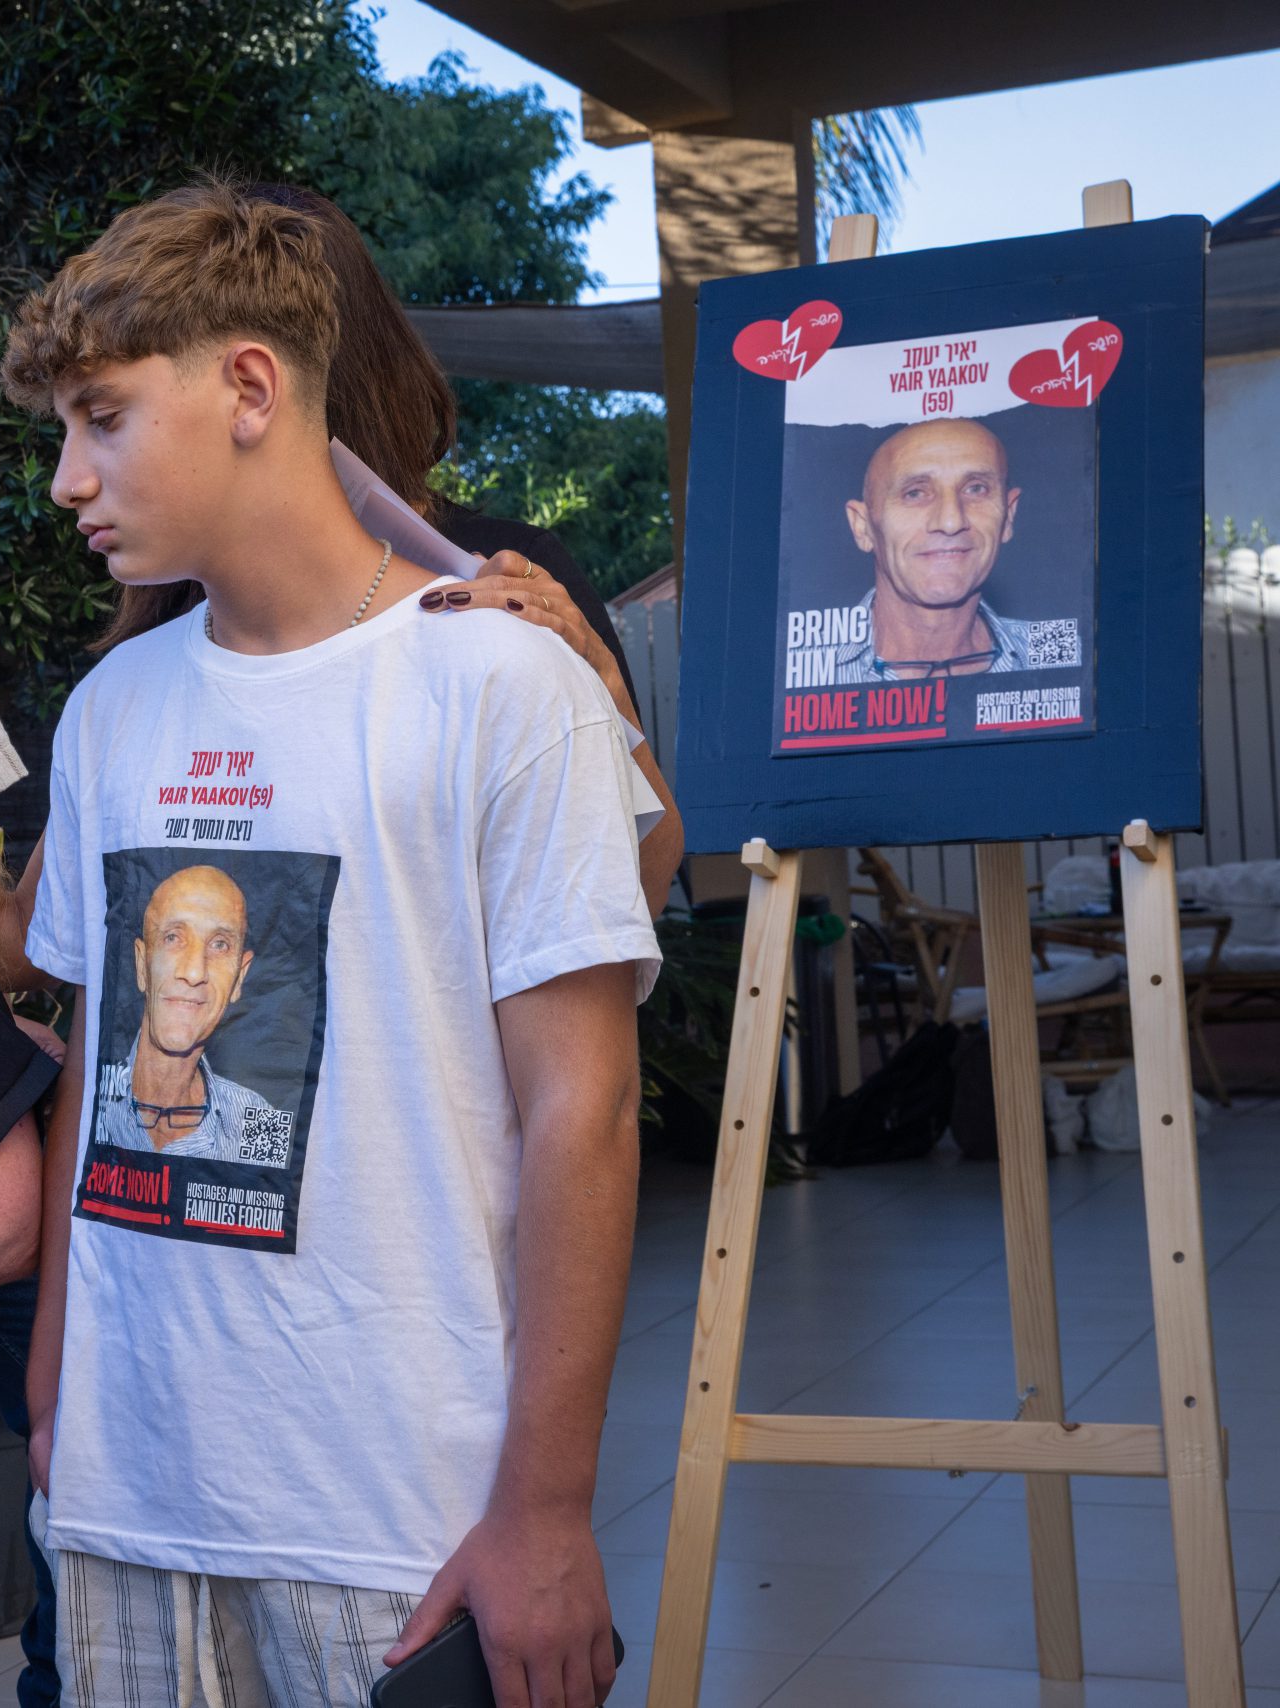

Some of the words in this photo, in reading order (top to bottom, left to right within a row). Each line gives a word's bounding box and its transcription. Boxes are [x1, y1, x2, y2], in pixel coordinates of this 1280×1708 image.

[901, 346, 940, 370] יעקב
[945, 340, 977, 363] יאיר
[889, 370, 923, 393] YAIR
[927, 362, 990, 389] YAAKOV
[922, 389, 954, 416] (59)
[787, 605, 868, 649] BRING
[785, 649, 837, 689] HIM
[784, 691, 861, 733] HOME
[866, 679, 945, 727] NOW!
[976, 690, 1021, 707] HOSTAGES
[1021, 689, 1040, 704] AND
[1041, 686, 1081, 702] MISSING
[976, 703, 1033, 725] FAMILIES
[1035, 700, 1081, 721] FORUM
[186, 751, 223, 779] יעקב
[226, 751, 255, 777] יאיר
[158, 786, 188, 805] YAIR
[224, 819, 254, 841] נרצח
[86, 1161, 124, 1198] HOME
[186, 1182, 227, 1203] HOSTAGES
[227, 1187, 244, 1205] AND
[245, 1190, 285, 1210] MISSING
[185, 1198, 237, 1227] FAMILIES
[238, 1205, 284, 1233] FORUM
